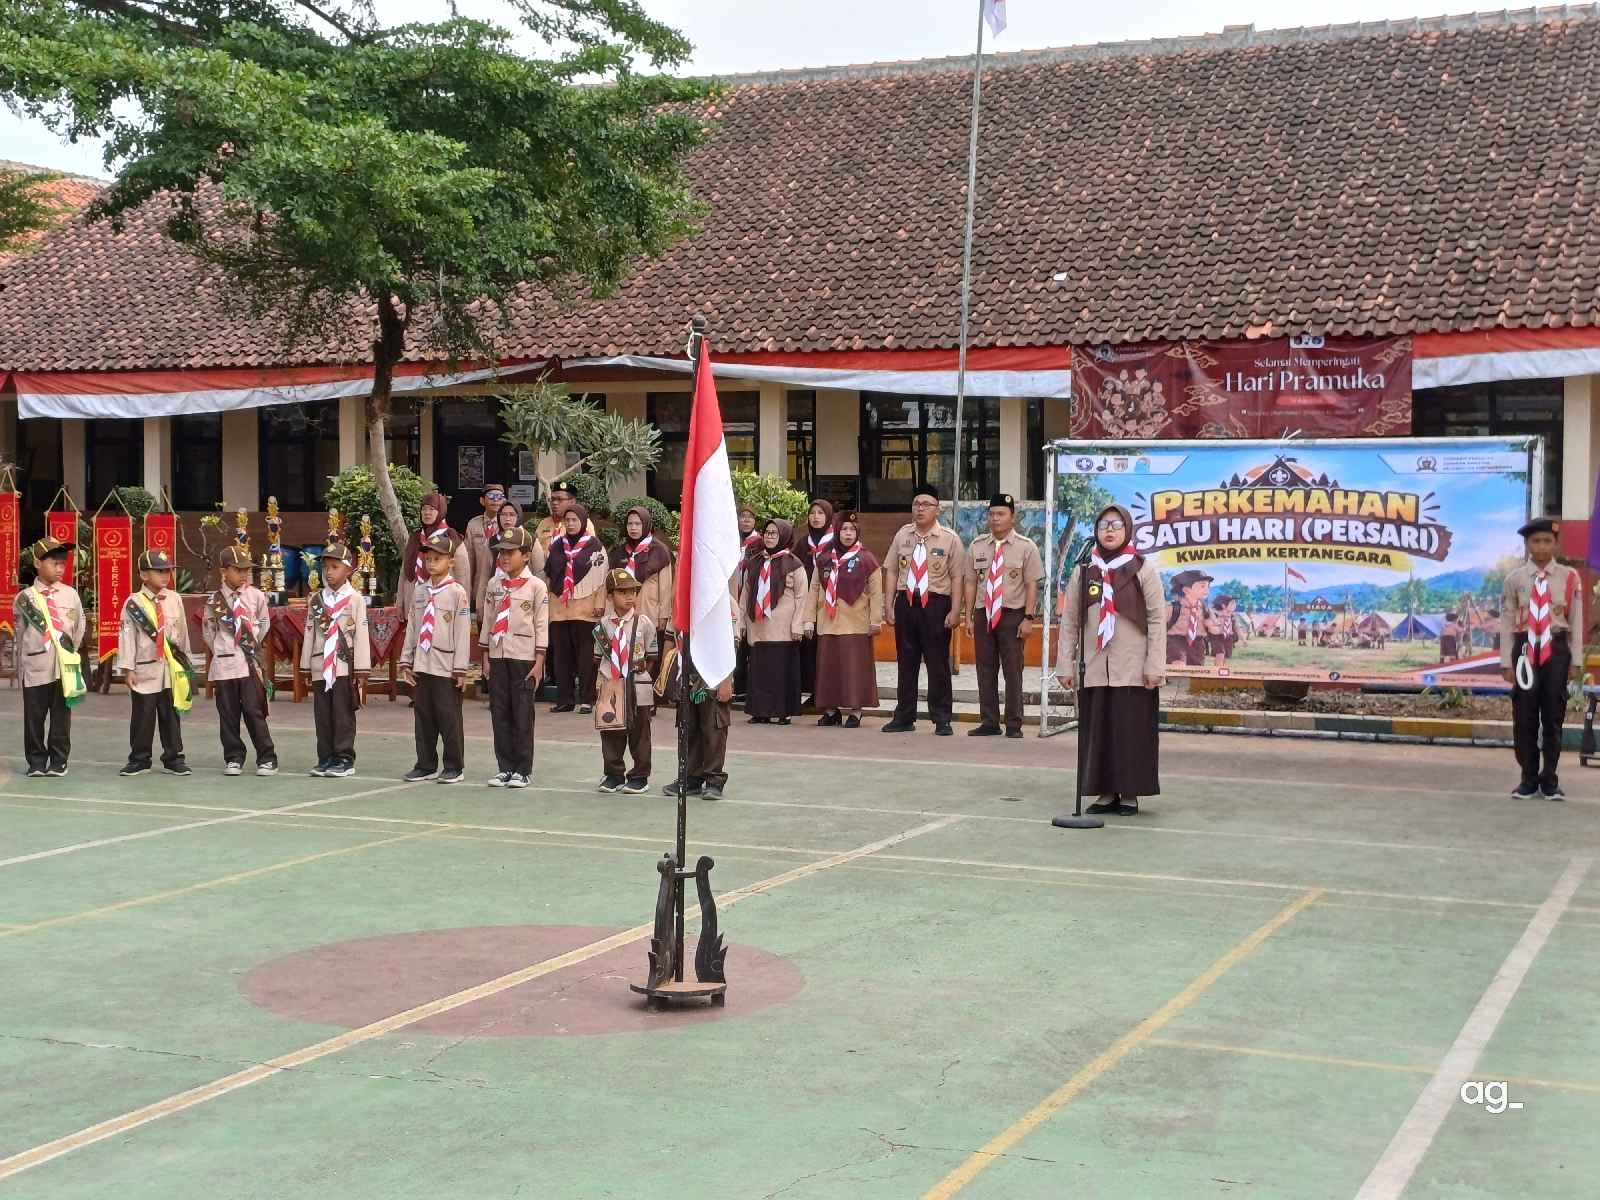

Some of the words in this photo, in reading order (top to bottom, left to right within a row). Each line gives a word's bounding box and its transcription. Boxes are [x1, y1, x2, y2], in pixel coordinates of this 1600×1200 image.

[1226, 372, 1273, 392] Hari
[1279, 368, 1385, 391] Pramuka
[1153, 489, 1416, 523] PERKEMAHAN
[1135, 519, 1211, 550] SATU
[1218, 518, 1294, 541] HARI
[1301, 517, 1439, 554] (PERSARI)
[1176, 547, 1261, 563] KWARRAN
[1266, 547, 1392, 566] KERTANEGARA
